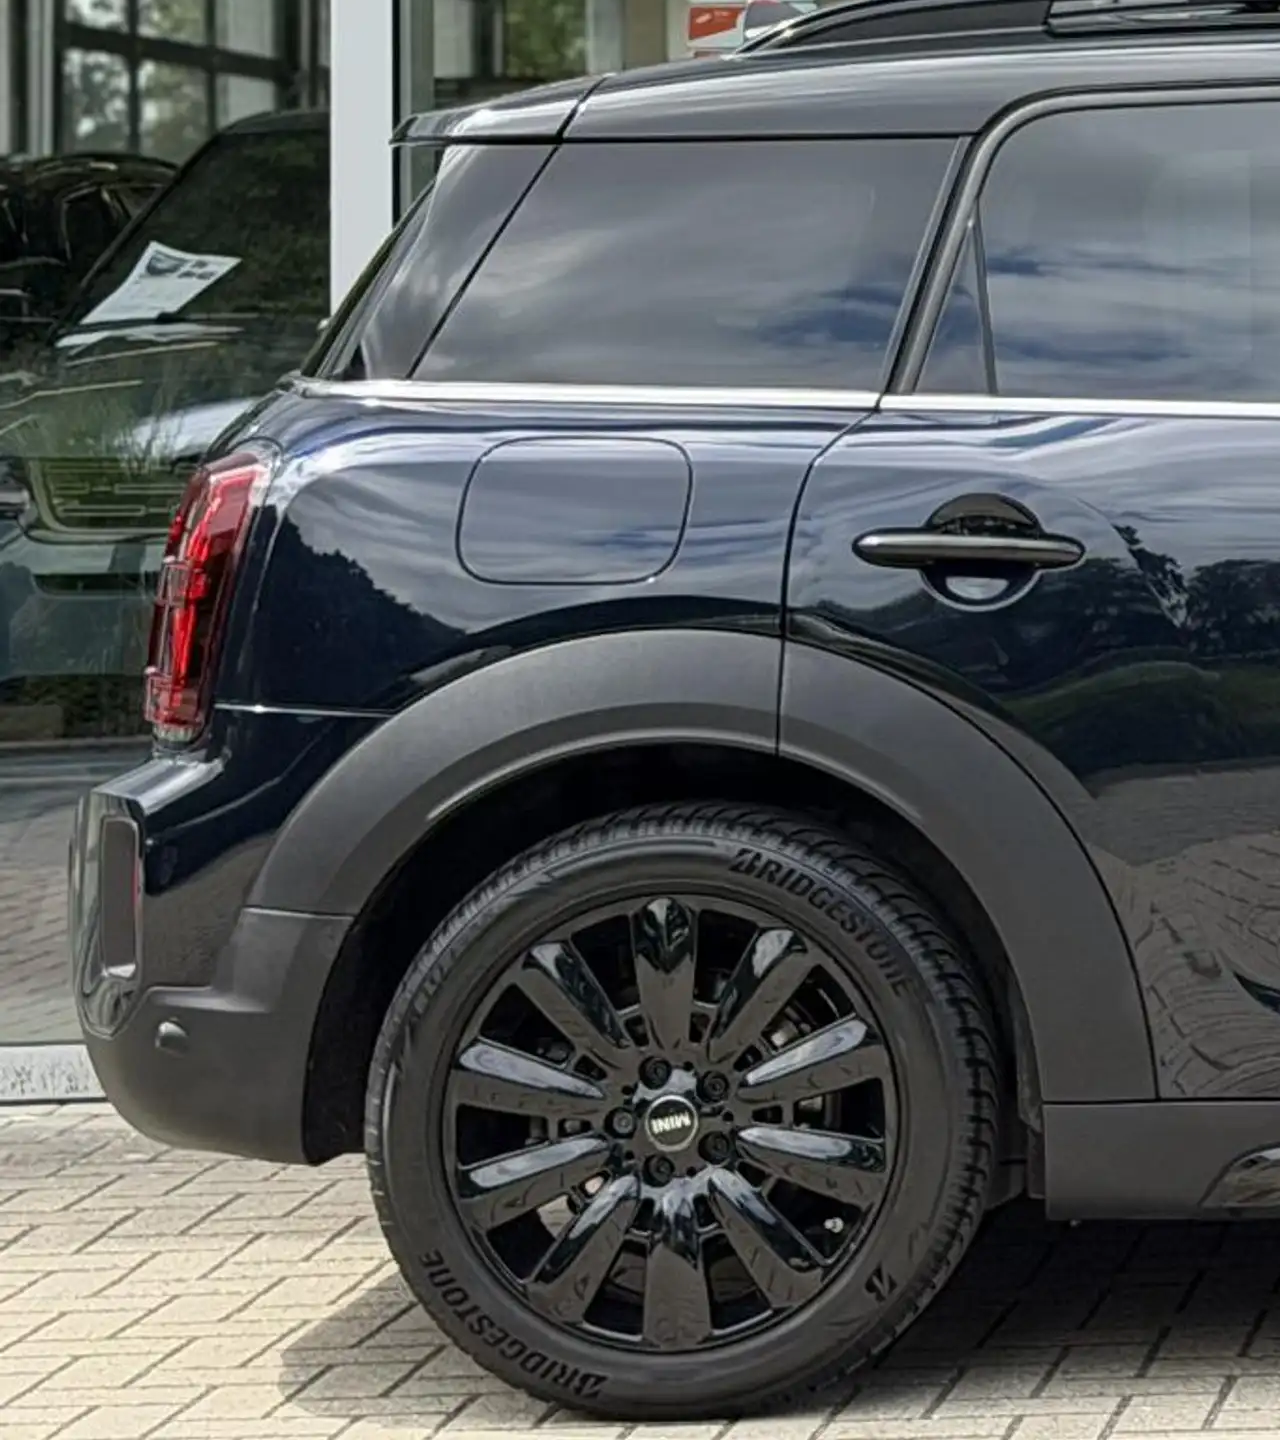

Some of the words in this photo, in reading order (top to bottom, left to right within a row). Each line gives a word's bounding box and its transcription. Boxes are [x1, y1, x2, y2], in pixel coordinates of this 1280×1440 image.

[728, 846, 908, 998] BRIDGESTONE
[650, 1110, 691, 1134] MINI
[417, 1247, 609, 1398] BRIDGESTONE
